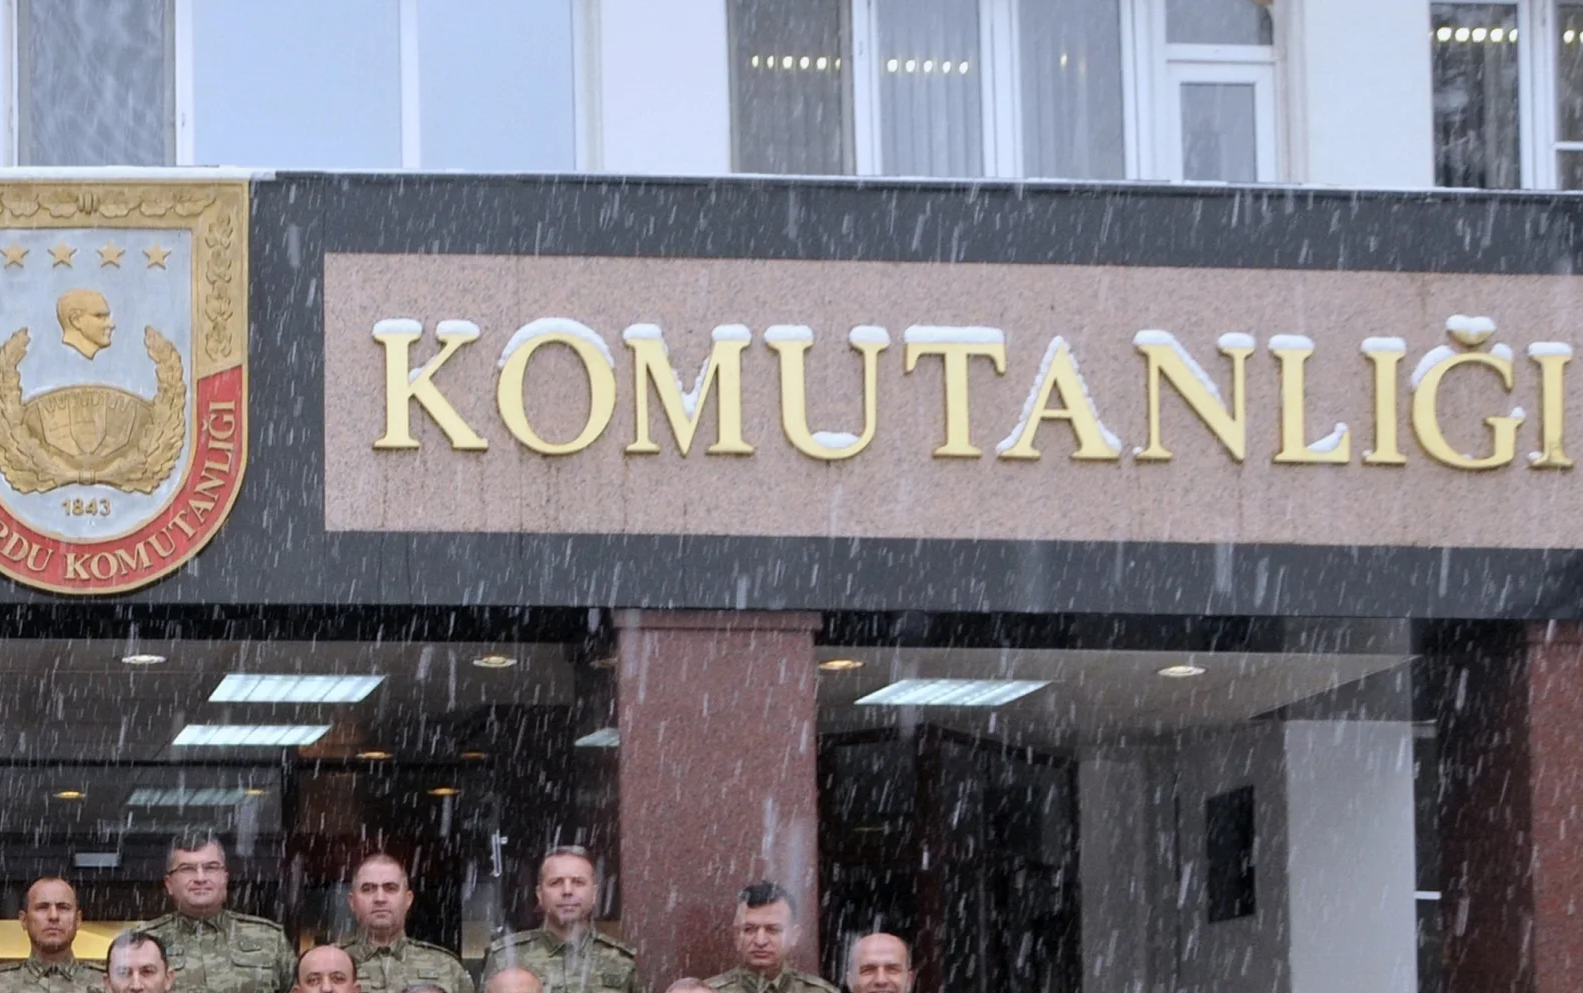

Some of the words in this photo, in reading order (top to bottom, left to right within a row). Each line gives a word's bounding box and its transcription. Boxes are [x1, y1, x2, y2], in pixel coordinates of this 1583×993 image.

[371, 316, 1575, 469] KOMUTANLIĞI
[62, 498, 111, 517] 1843
[64, 401, 235, 580] KOMUTANLIĞI
